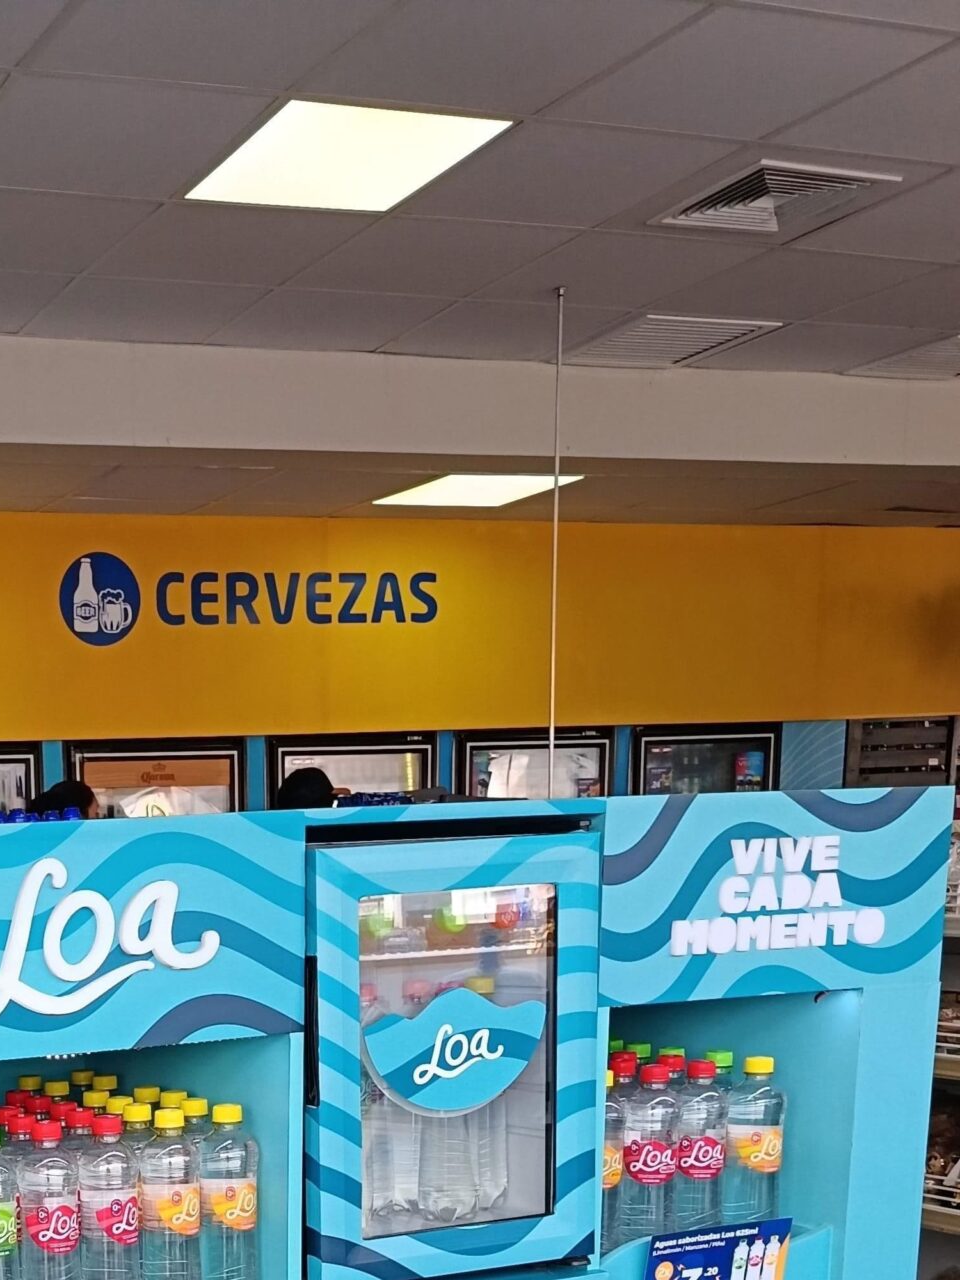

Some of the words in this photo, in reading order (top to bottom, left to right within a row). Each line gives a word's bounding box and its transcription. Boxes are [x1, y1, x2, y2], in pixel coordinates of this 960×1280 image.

[155, 571, 438, 626] CERVEZAS
[730, 835, 840, 875] VIVE
[719, 872, 842, 913] CADA
[670, 907, 885, 957] MOMENTO
[413, 1024, 504, 1085] Loa
[630, 1140, 677, 1172] Loa
[680, 1140, 724, 1168] Loa
[750, 1132, 782, 1161] Lo
[112, 1202, 138, 1234] Lo
[172, 1193, 199, 1224] Lo
[226, 1189, 256, 1220] Lo
